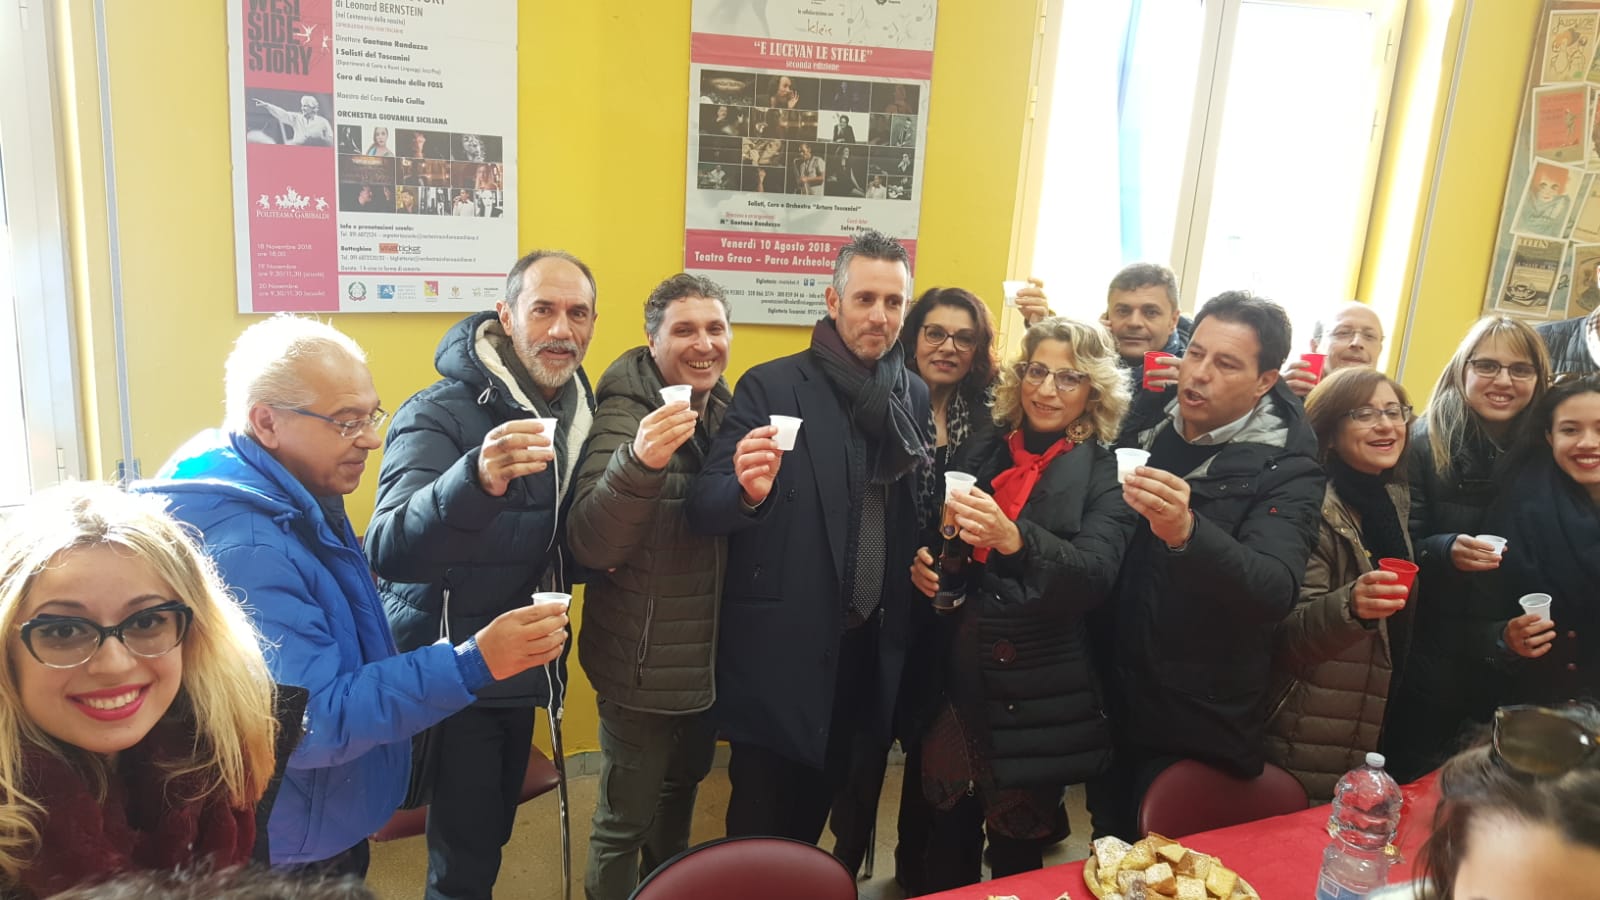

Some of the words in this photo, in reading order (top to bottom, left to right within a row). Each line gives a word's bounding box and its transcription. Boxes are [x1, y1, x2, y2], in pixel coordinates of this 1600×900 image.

[345, 0, 377, 12] Leonard
[379, 3, 424, 17] BERNSTEIN
[248, 12, 302, 46] SIDE
[336, 34, 361, 43] Direttore
[362, 37, 392, 47] Gaetano
[394, 41, 428, 50] Randazzo
[248, 41, 313, 76] STORY
[340, 48, 363, 57] Solisti
[365, 50, 377, 58] del
[378, 52, 411, 61] Toscanini
[769, 42, 814, 58] LUCEVAN
[816, 46, 829, 60] LE
[785, 60, 812, 70] seconda
[813, 62, 840, 71] edizione
[364, 75, 378, 83] voci
[380, 76, 407, 85] bianche
[408, 79, 426, 87] della
[427, 81, 444, 89] FOSS
[384, 96, 404, 104] Fabio
[337, 110, 378, 120] ORCHESTRA
[379, 113, 415, 123] GIOVANILE
[416, 116, 448, 125] SICILIANA
[786, 202, 811, 210] Orchestra
[256, 209, 294, 219] POLITEAMA
[294, 210, 330, 220] GARIBALDI
[720, 237, 757, 249] Venerdì
[760, 239, 772, 249] 10
[774, 240, 805, 254] Agosto
[808, 242, 831, 253] 2018
[694, 251, 724, 263] Teatro
[727, 252, 753, 264] Greco
[764, 255, 789, 266] Parco
[792, 255, 837, 270] Archeolog
